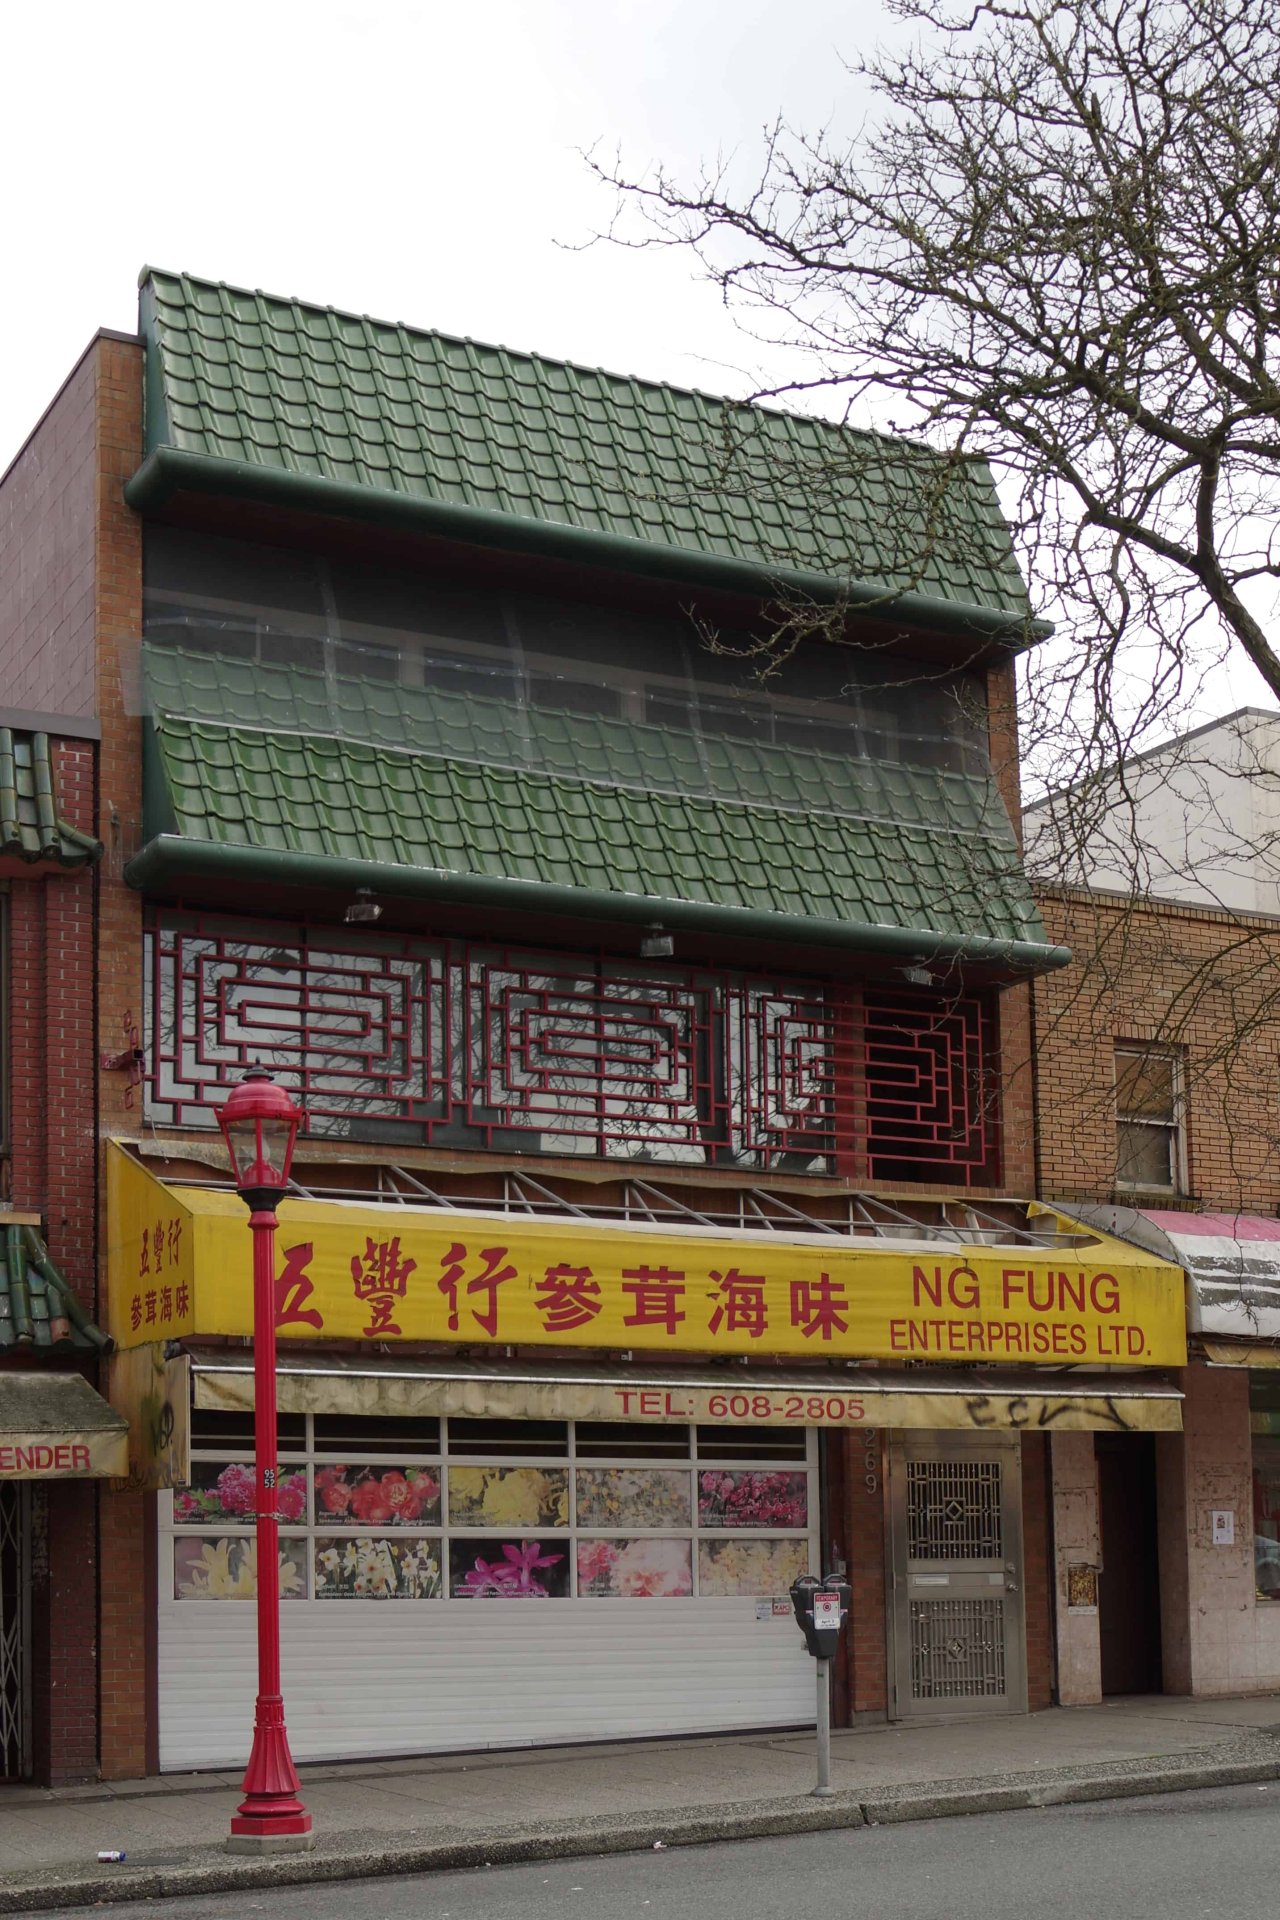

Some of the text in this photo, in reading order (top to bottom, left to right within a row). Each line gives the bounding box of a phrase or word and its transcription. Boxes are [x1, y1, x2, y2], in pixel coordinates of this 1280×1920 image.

[912, 1265, 1121, 1314] NG FUNG
[890, 1319, 1152, 1356] ENTERPRISES LTD.
[616, 1391, 865, 1420] TEL: 608-2805
[0, 1444, 91, 1471] ENDER
[264, 1469, 274, 1478] 95
[264, 1479, 275, 1488] 52
